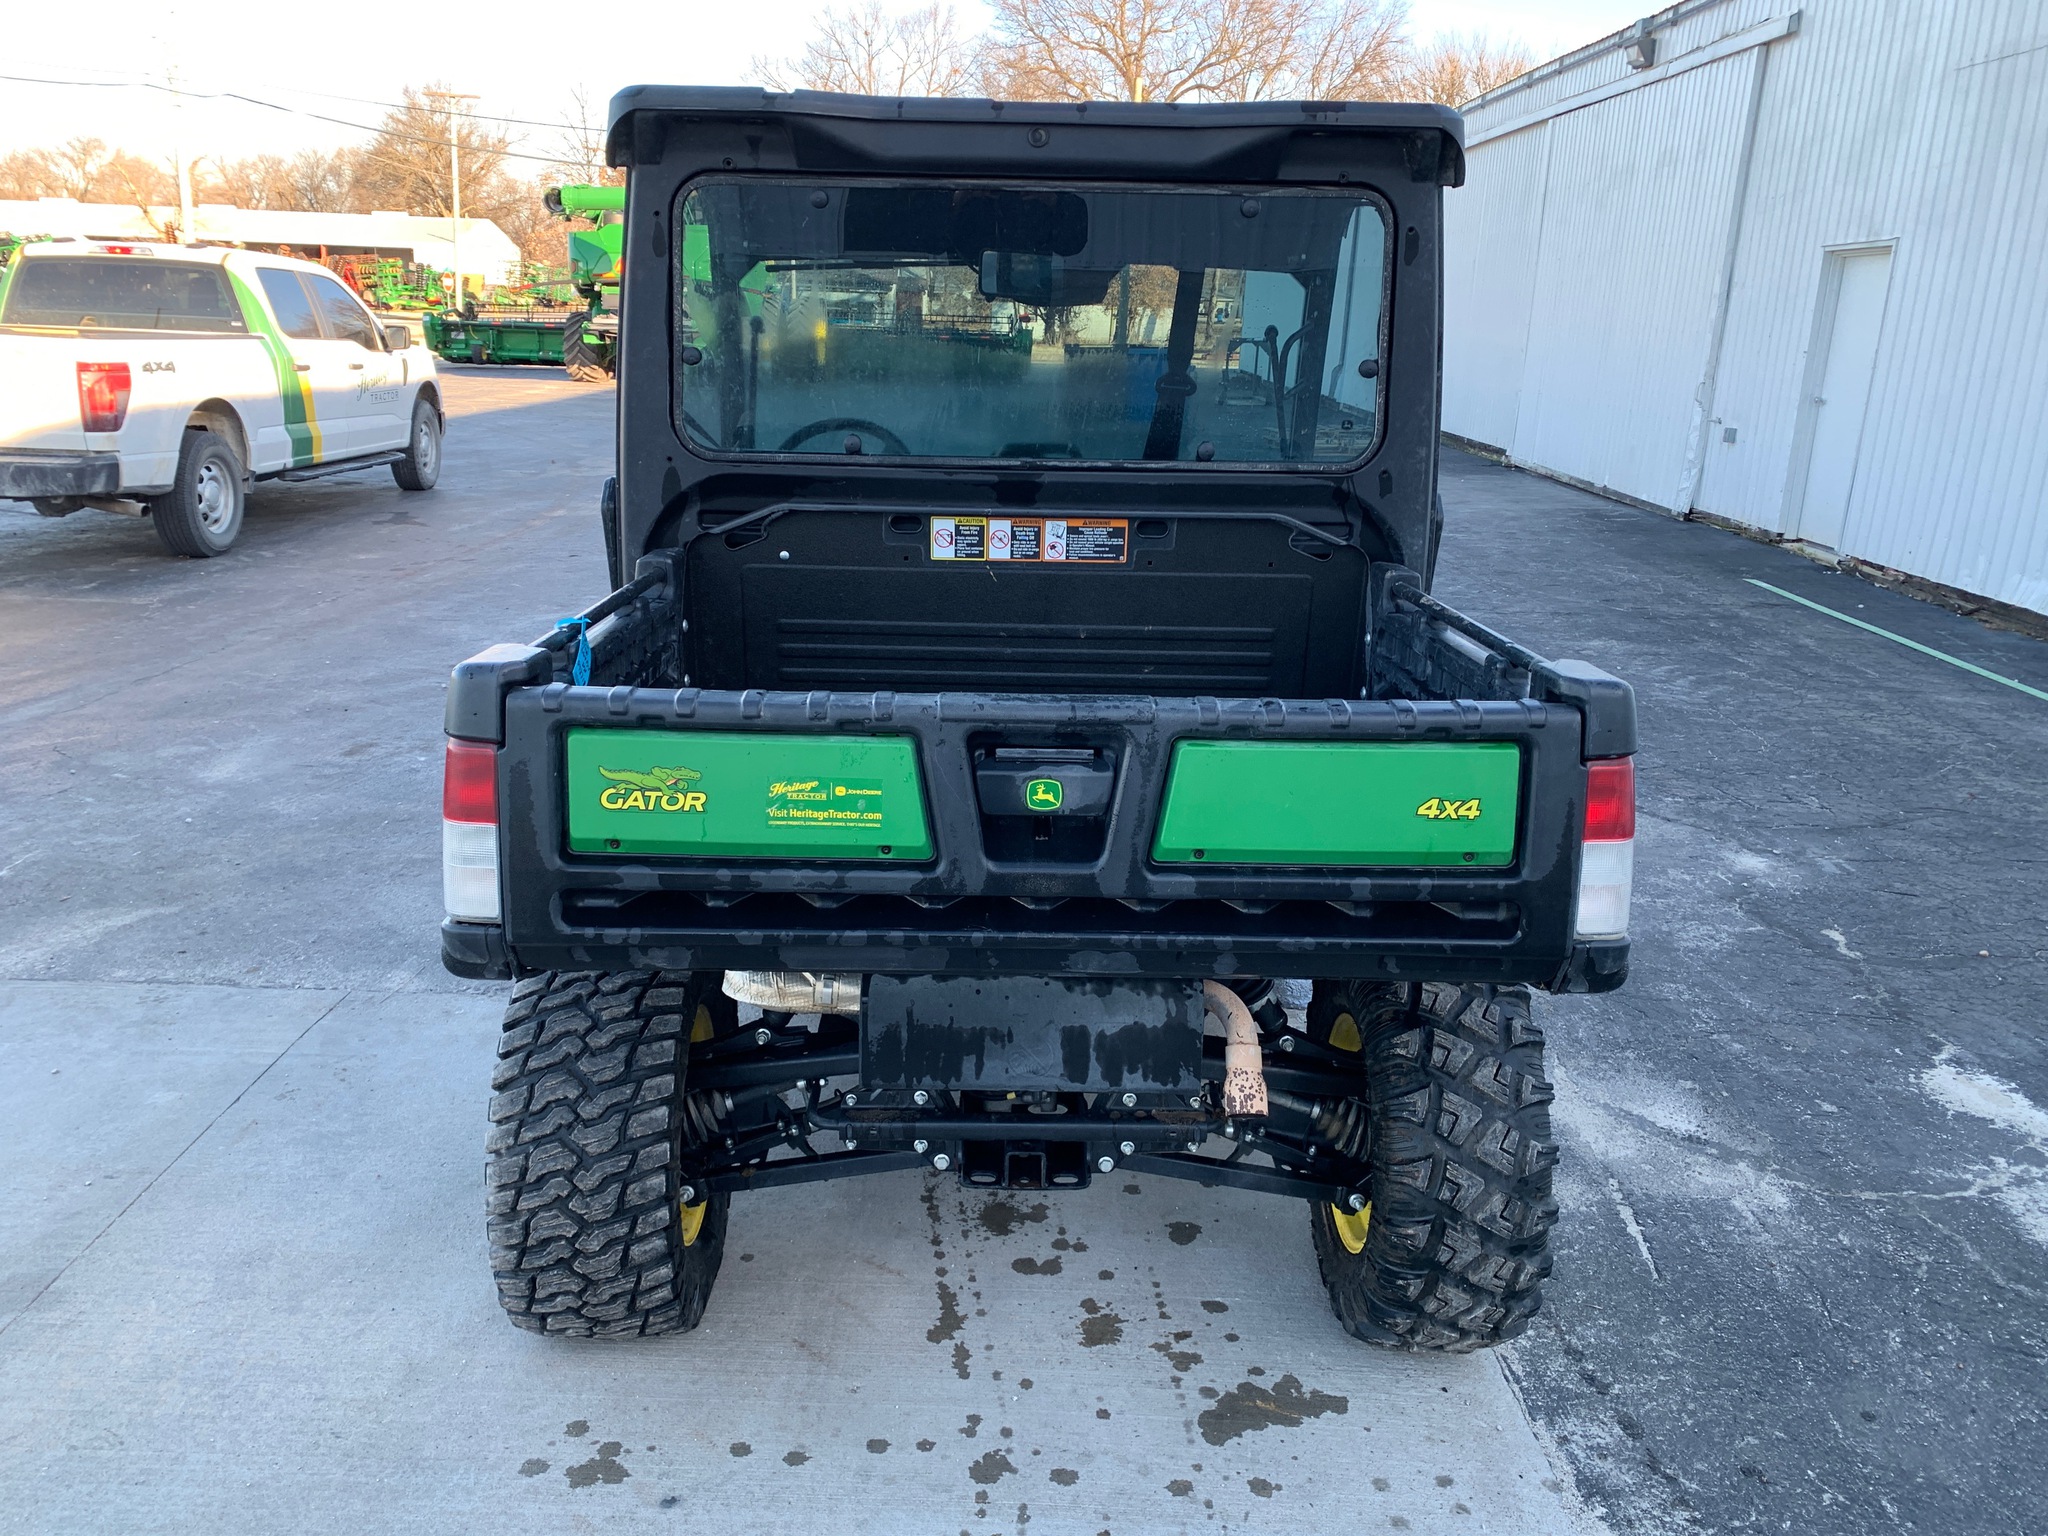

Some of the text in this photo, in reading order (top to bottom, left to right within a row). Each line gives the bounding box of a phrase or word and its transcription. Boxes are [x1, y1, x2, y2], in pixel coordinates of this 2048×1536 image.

[370, 390, 400, 403] TRACTOR
[768, 780, 820, 798] Heritage
[600, 787, 708, 813] GATOR
[787, 792, 827, 800] TRACTOR
[768, 808, 882, 820] Visit HeritageTractor.com
